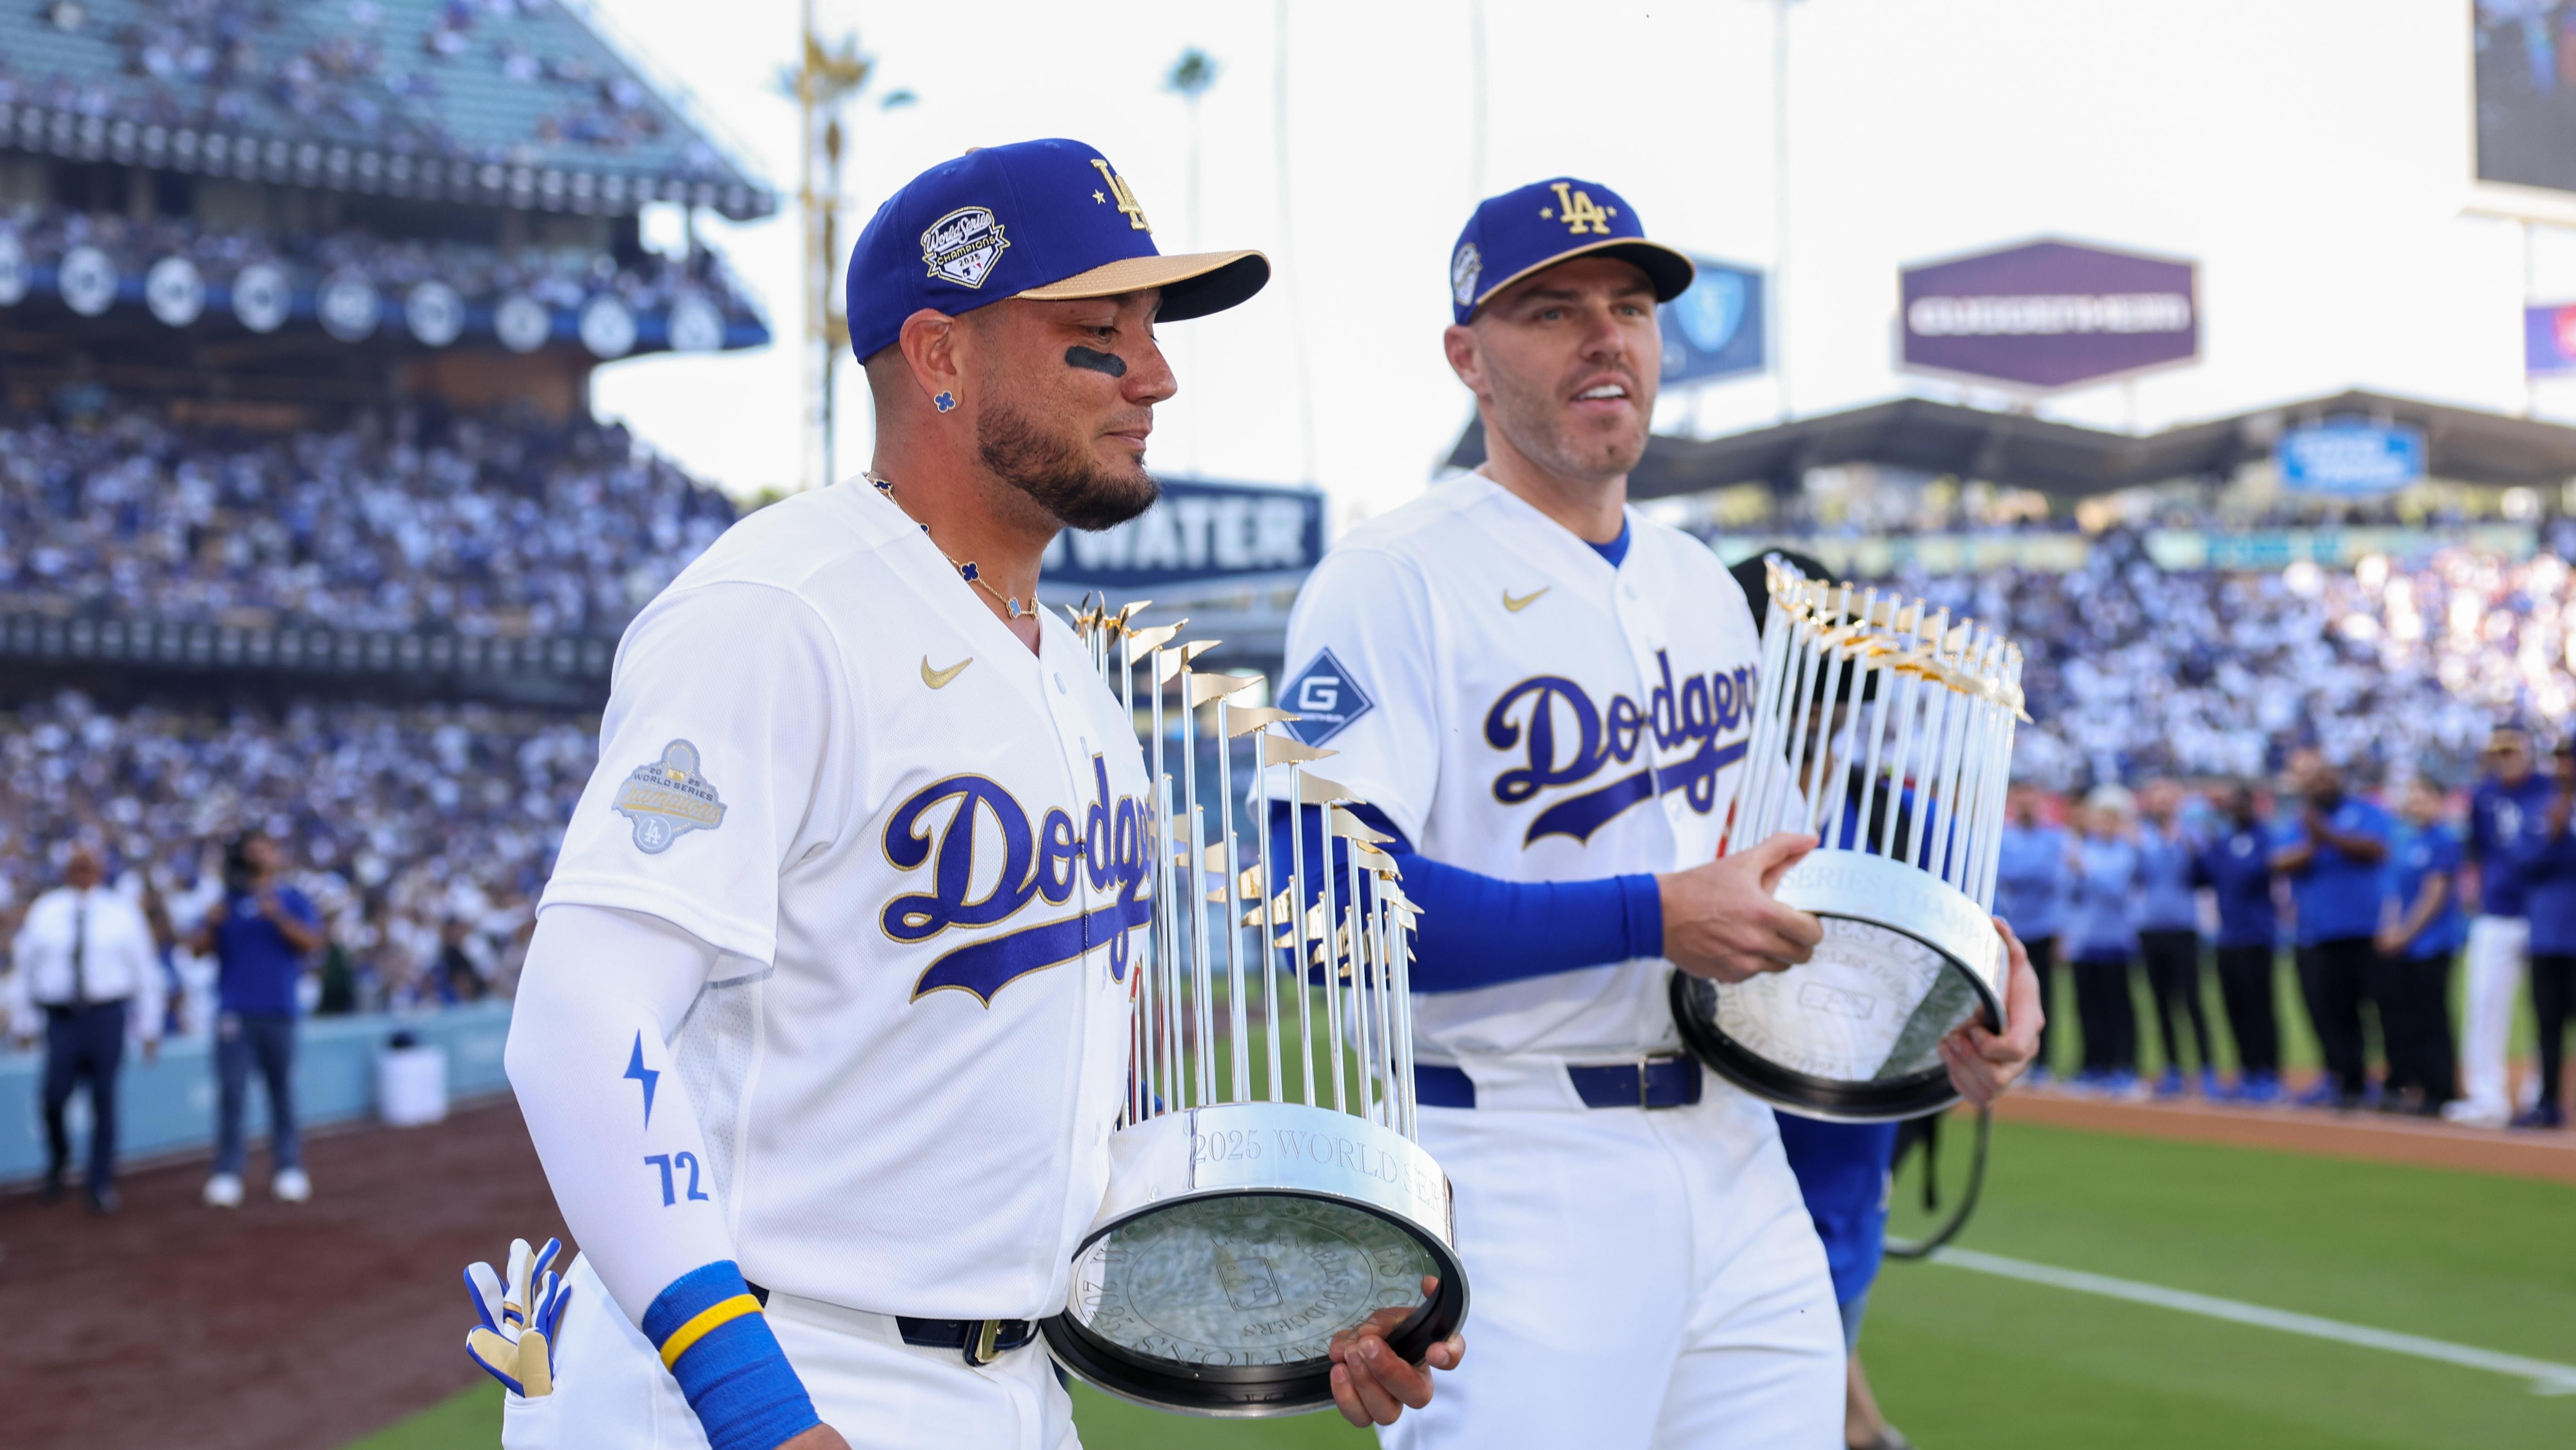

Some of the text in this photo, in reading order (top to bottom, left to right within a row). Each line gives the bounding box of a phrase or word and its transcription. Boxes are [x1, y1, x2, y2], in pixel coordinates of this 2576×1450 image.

[1551, 182, 1611, 234] LA
[925, 212, 992, 253] World Series
[937, 236, 995, 265] CHAMPIONS
[1298, 677, 1340, 711] G
[1483, 647, 1758, 816] Dodger
[634, 773, 714, 802] WORLD SERIES
[645, 819, 661, 844] LA
[1192, 1129, 1262, 1165] 2025
[1273, 1128, 1398, 1184] WORLD
[644, 1151, 710, 1207] 72
